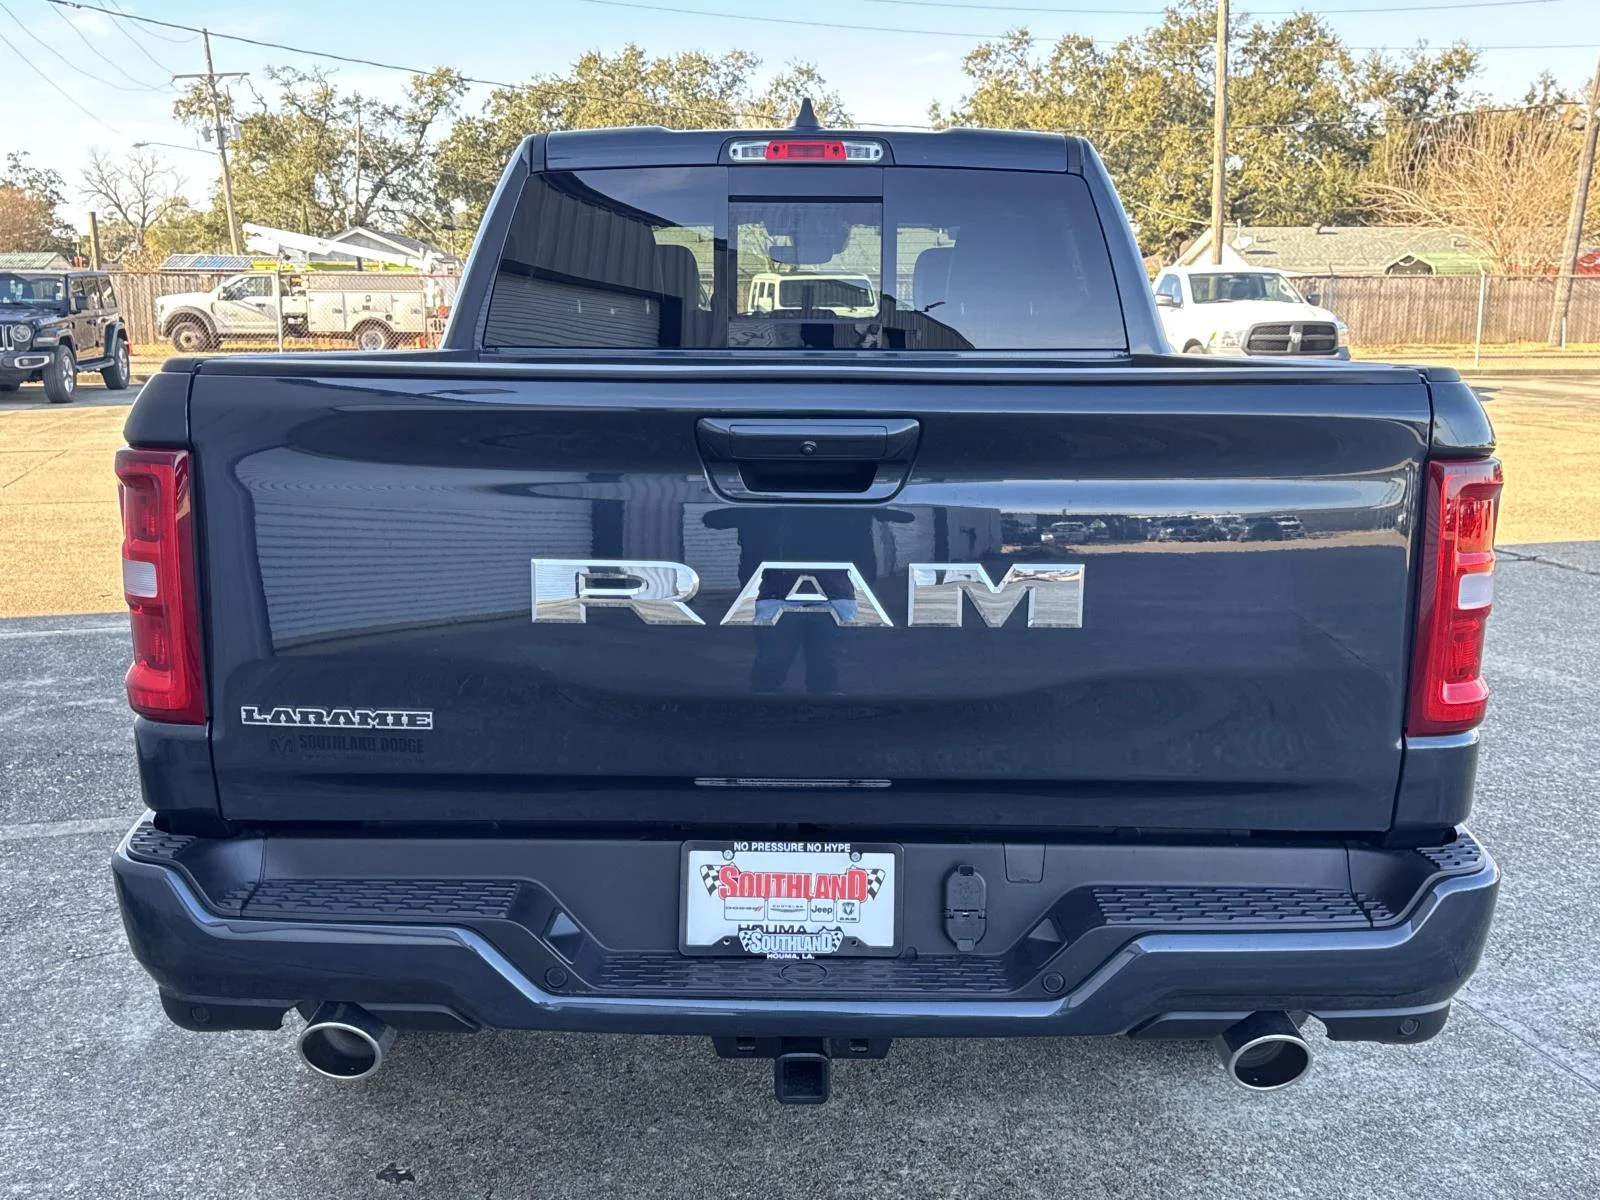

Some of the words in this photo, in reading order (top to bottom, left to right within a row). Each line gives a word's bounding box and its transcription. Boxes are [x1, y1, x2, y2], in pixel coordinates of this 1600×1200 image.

[531, 558, 1085, 628] RAM
[241, 706, 434, 730] LARAMIE
[299, 734, 376, 752] SOUTHLAND
[379, 737, 425, 754] DODGE
[733, 841, 749, 851] NO
[751, 842, 805, 852] PRESSURE
[806, 842, 823, 852] NO
[824, 843, 851, 853] HYPE
[718, 864, 868, 903] SOUTHLAND
[811, 905, 833, 915] Jeep
[750, 932, 834, 953] SOUTHLAND
